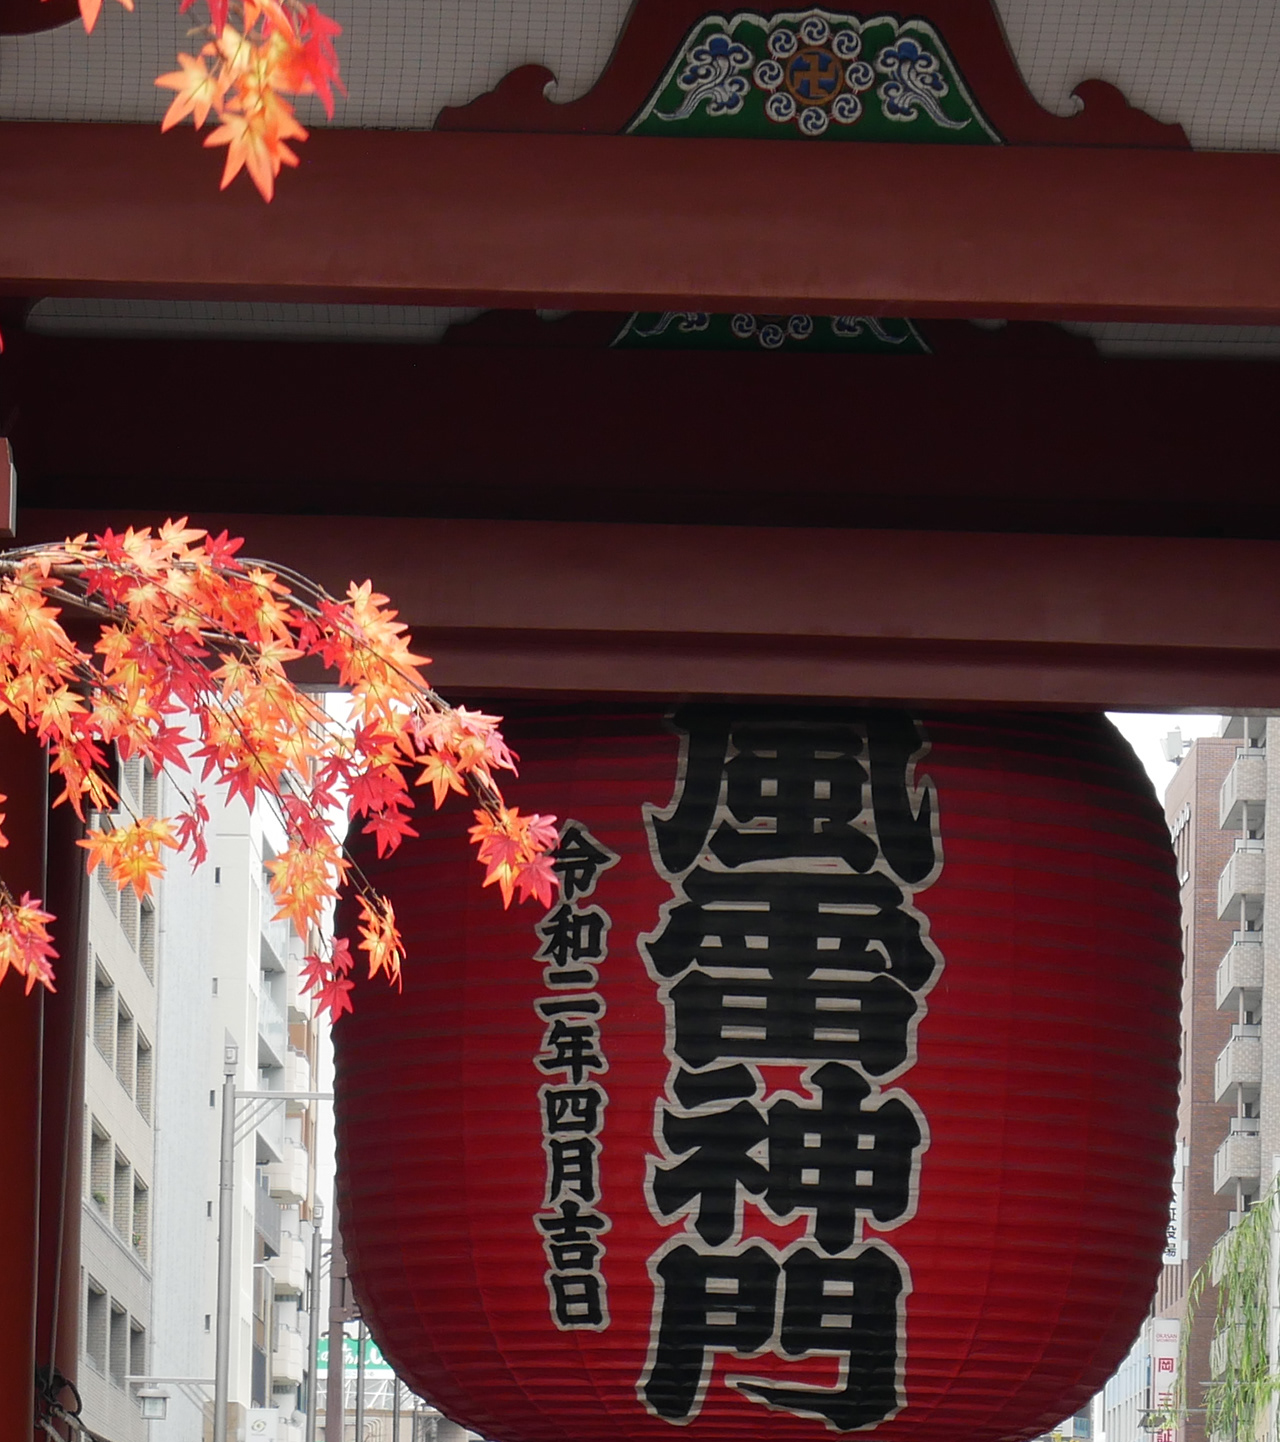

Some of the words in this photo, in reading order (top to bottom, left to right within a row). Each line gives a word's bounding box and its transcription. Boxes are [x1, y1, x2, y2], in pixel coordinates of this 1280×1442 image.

[534, 819, 619, 1332] 令和二年四月吉日
[636, 703, 945, 1432] 風雷神門
